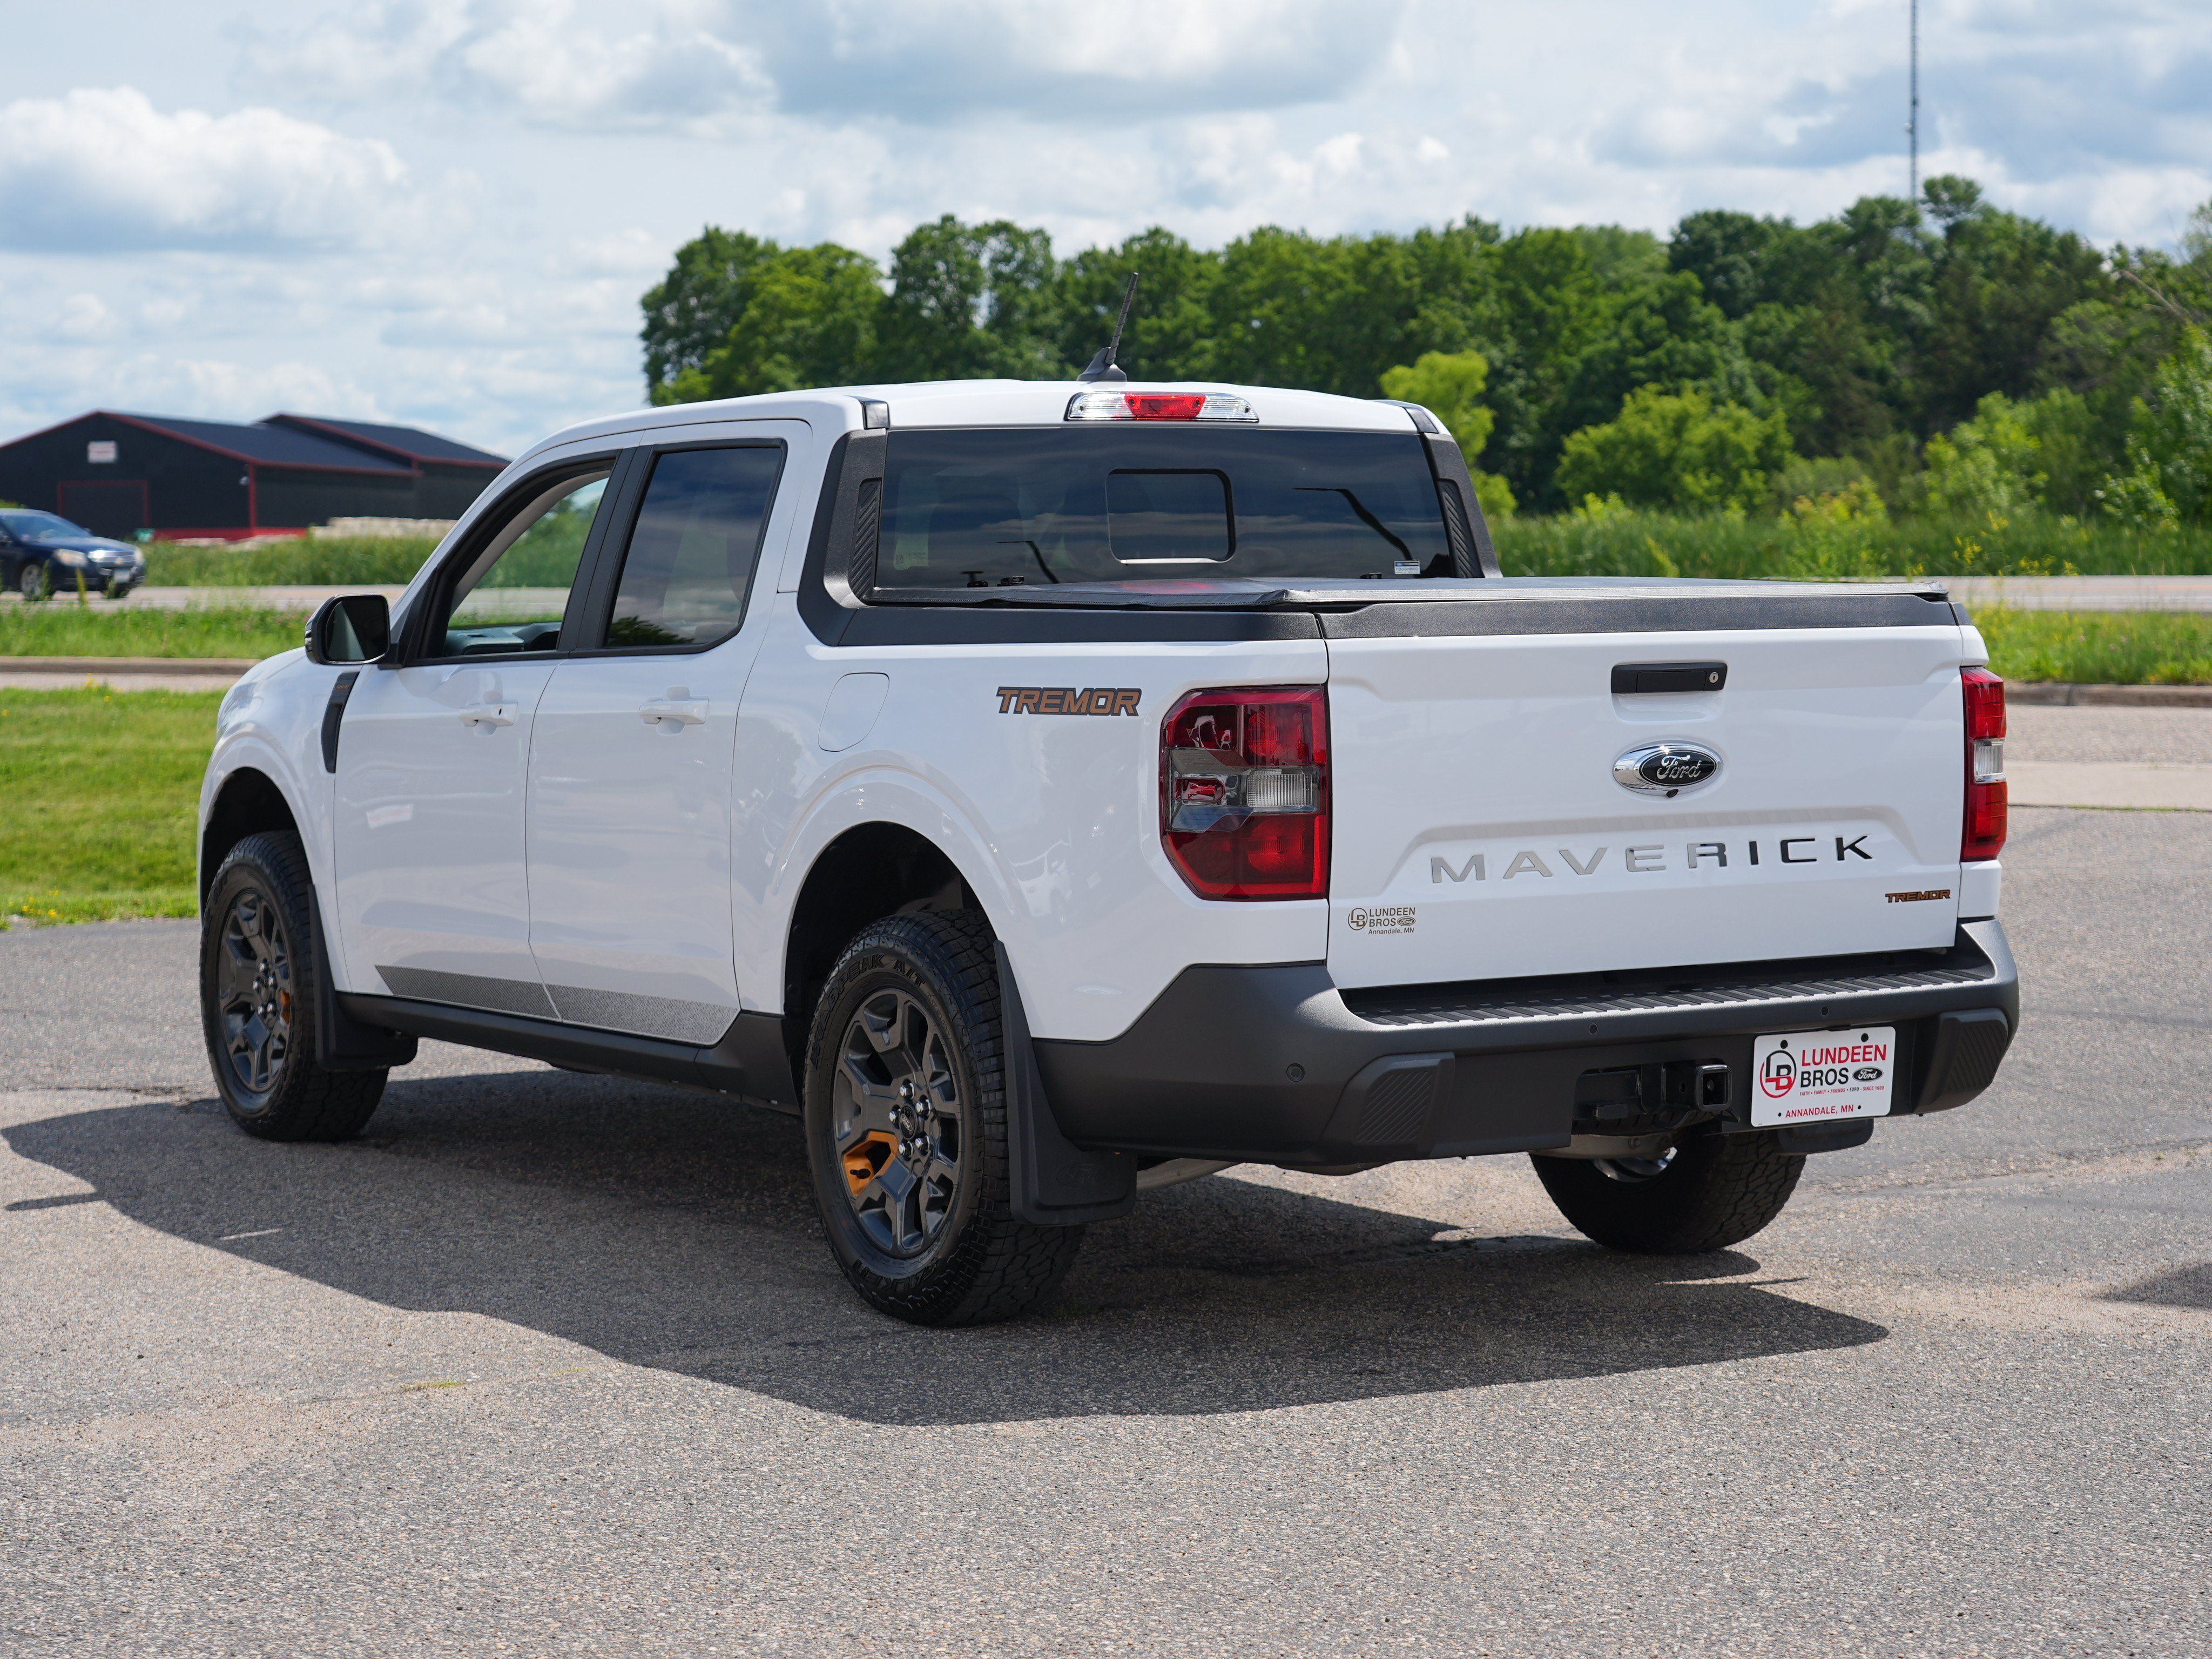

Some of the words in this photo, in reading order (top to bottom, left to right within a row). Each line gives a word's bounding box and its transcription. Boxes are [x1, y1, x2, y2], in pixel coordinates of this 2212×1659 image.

[996, 686, 1142, 716] TREMOR
[1656, 754, 1702, 780] Ford
[1431, 835, 1874, 884] MAVERICK
[1885, 889, 1951, 903] TREMOR
[1369, 907, 1415, 917] LUNDEEN
[1369, 918, 1396, 927] BROS
[1802, 1044, 1887, 1067] LUNDEEN
[1800, 1067, 1849, 1088] BROS
[1785, 1105, 1838, 1118] ANNANDALE,
[1840, 1104, 1854, 1113] MN
